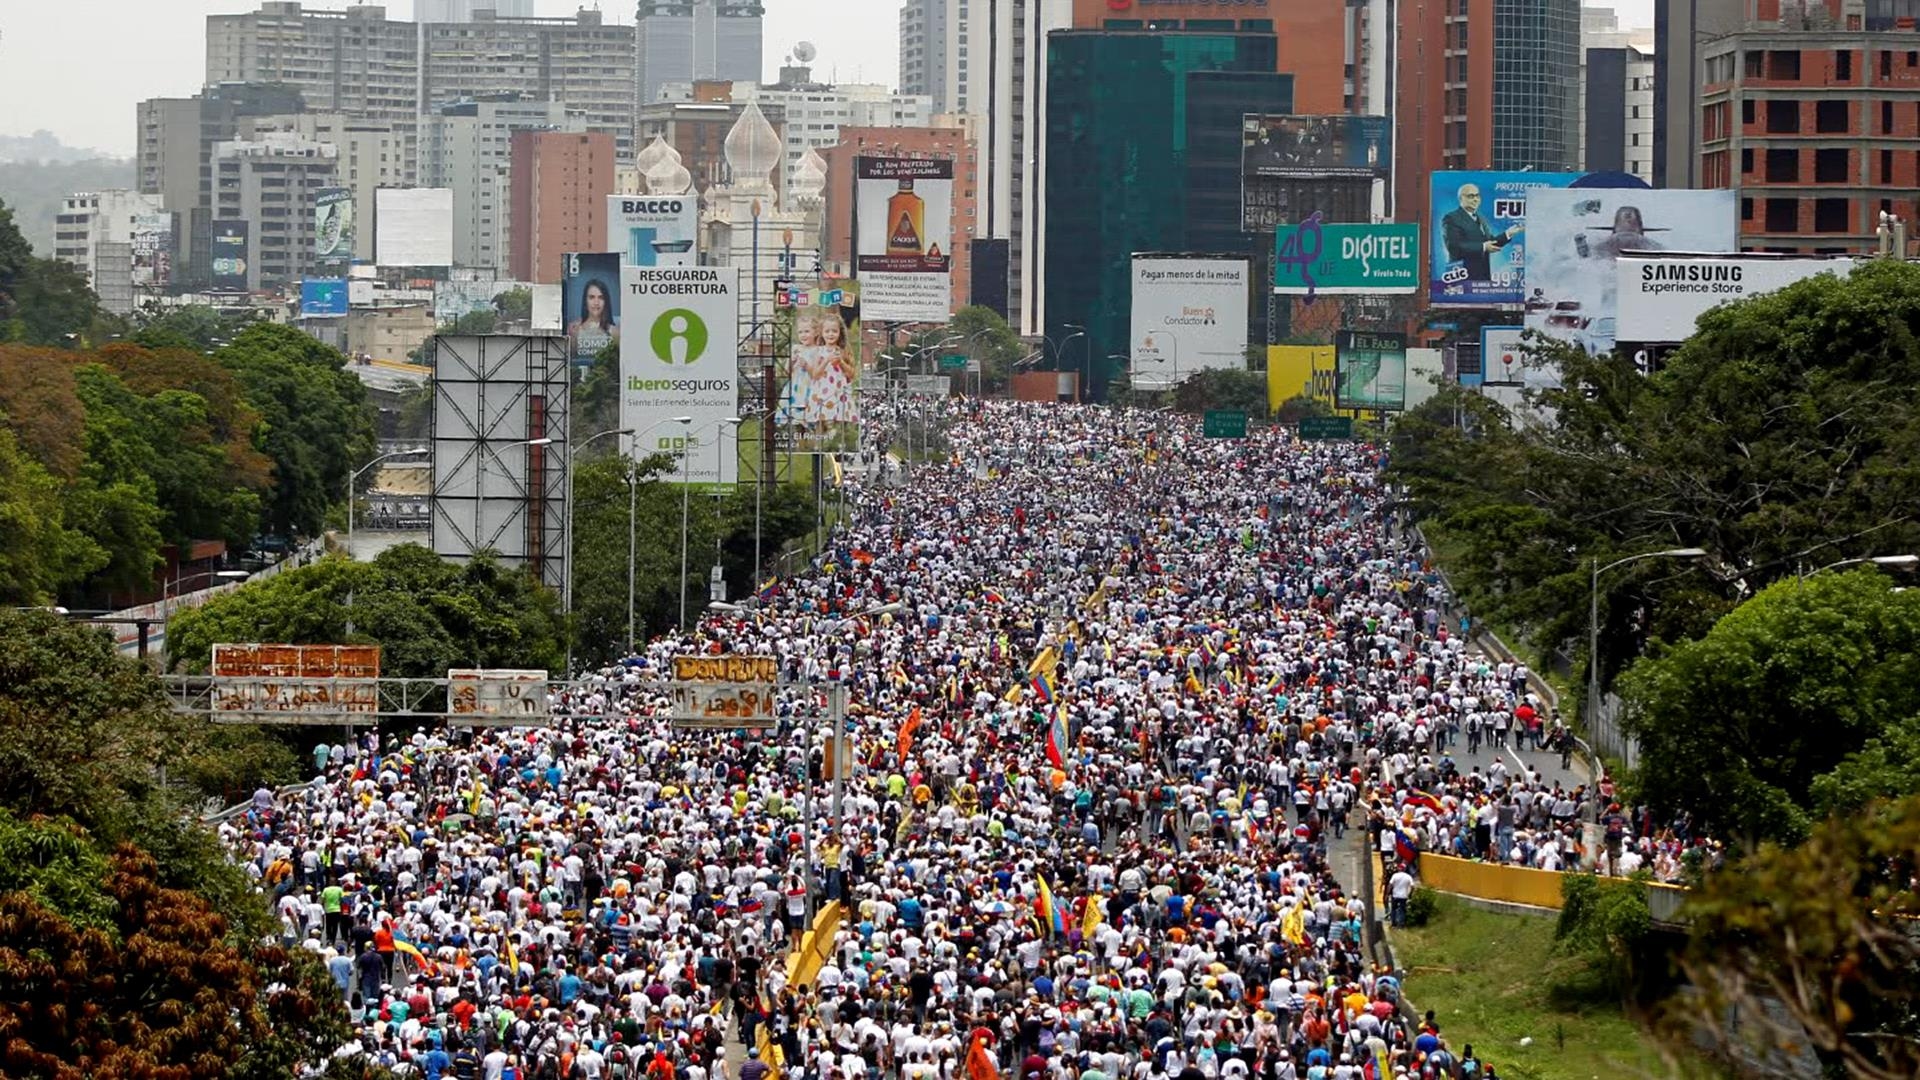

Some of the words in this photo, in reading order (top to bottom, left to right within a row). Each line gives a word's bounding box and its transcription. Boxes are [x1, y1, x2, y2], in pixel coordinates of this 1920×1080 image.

[622, 201, 682, 214] BACCO
[1496, 200, 1526, 217] FU
[1342, 234, 1410, 277] DIGITEL
[640, 270, 718, 281] RESGUARDA
[1141, 269, 1165, 280] Pagas
[1196, 270, 1206, 279] de
[1207, 270, 1215, 279] la
[1216, 270, 1240, 280] mitad
[1642, 264, 1742, 281] SAMSUNG
[631, 284, 648, 294] TU
[651, 284, 728, 294] COBERTURA
[1642, 282, 1709, 295] Experience
[1712, 282, 1743, 293] Store
[1183, 307, 1203, 316] Buen
[1164, 316, 1203, 326] Conductor
[1357, 338, 1369, 348] EL
[1372, 338, 1399, 349] FARO
[628, 376, 730, 395] iberoseguros
